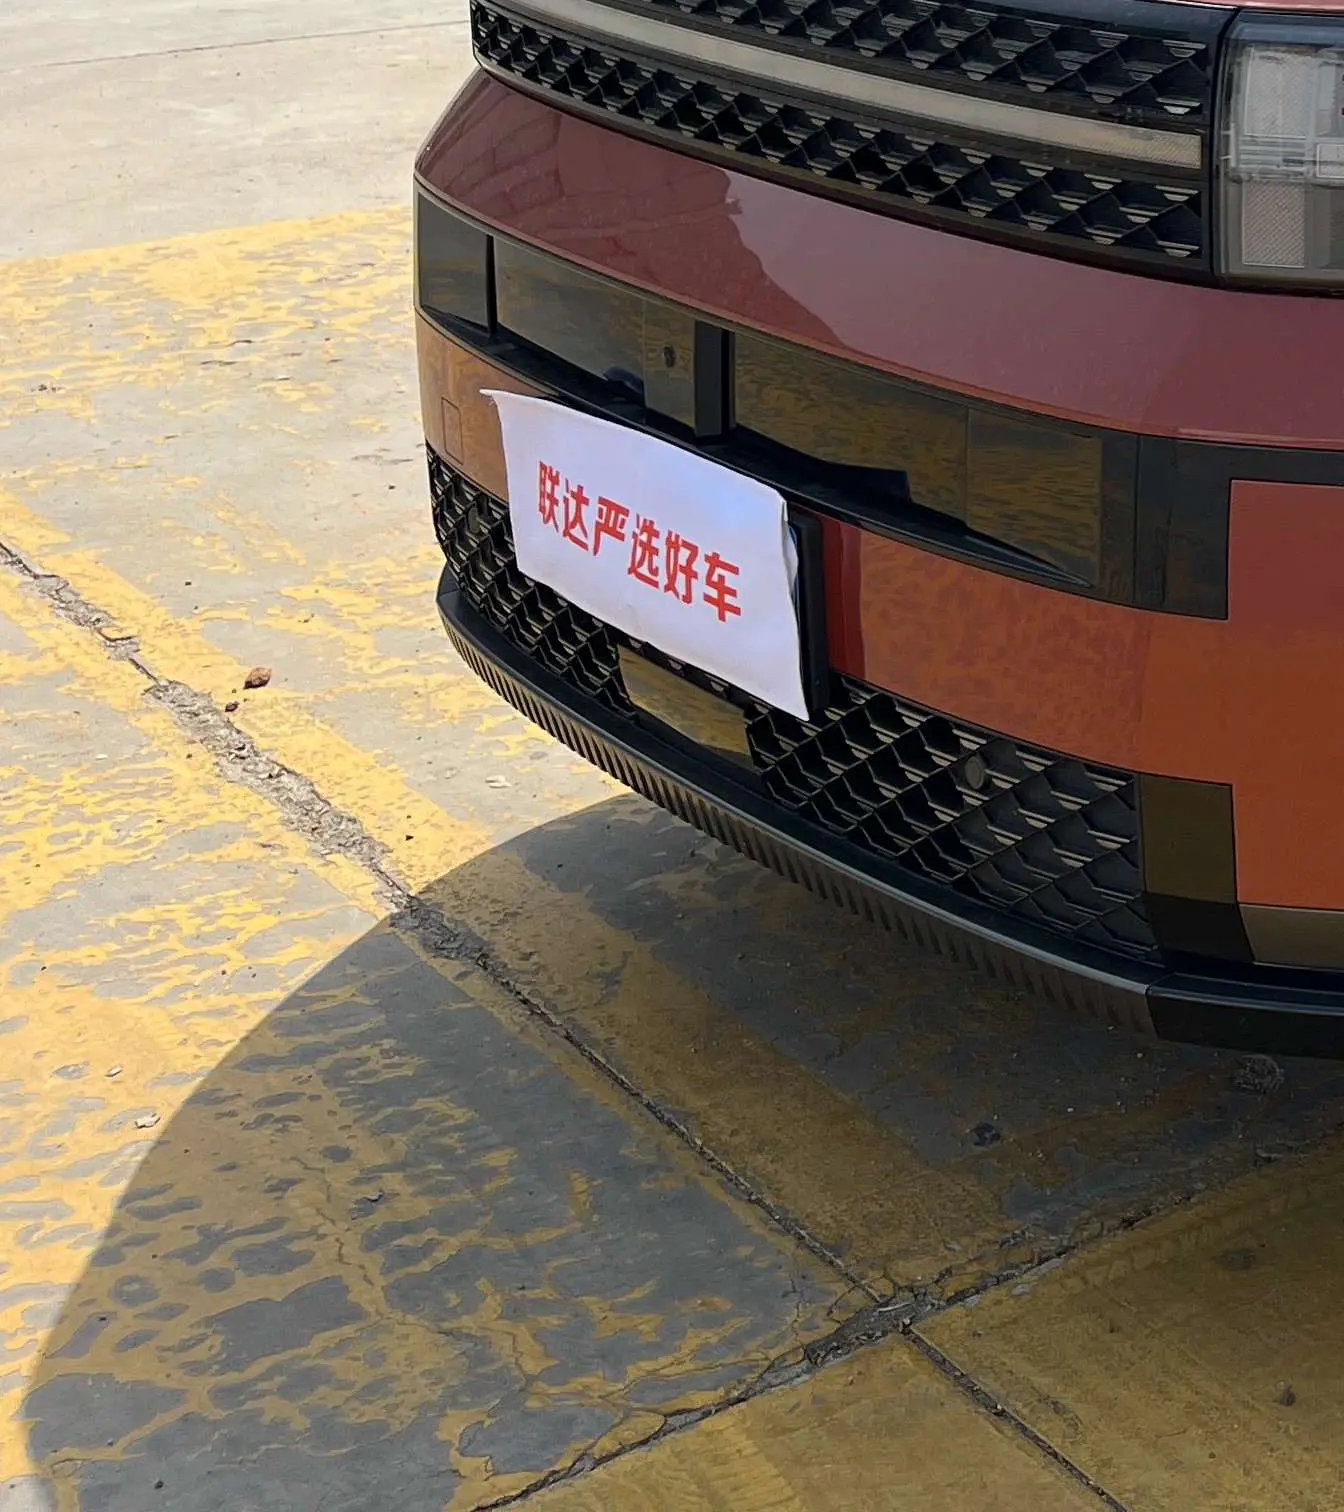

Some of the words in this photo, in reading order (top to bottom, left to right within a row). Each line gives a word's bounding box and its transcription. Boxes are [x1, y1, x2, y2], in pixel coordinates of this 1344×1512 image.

[537, 460, 743, 623] 联达严选好车
